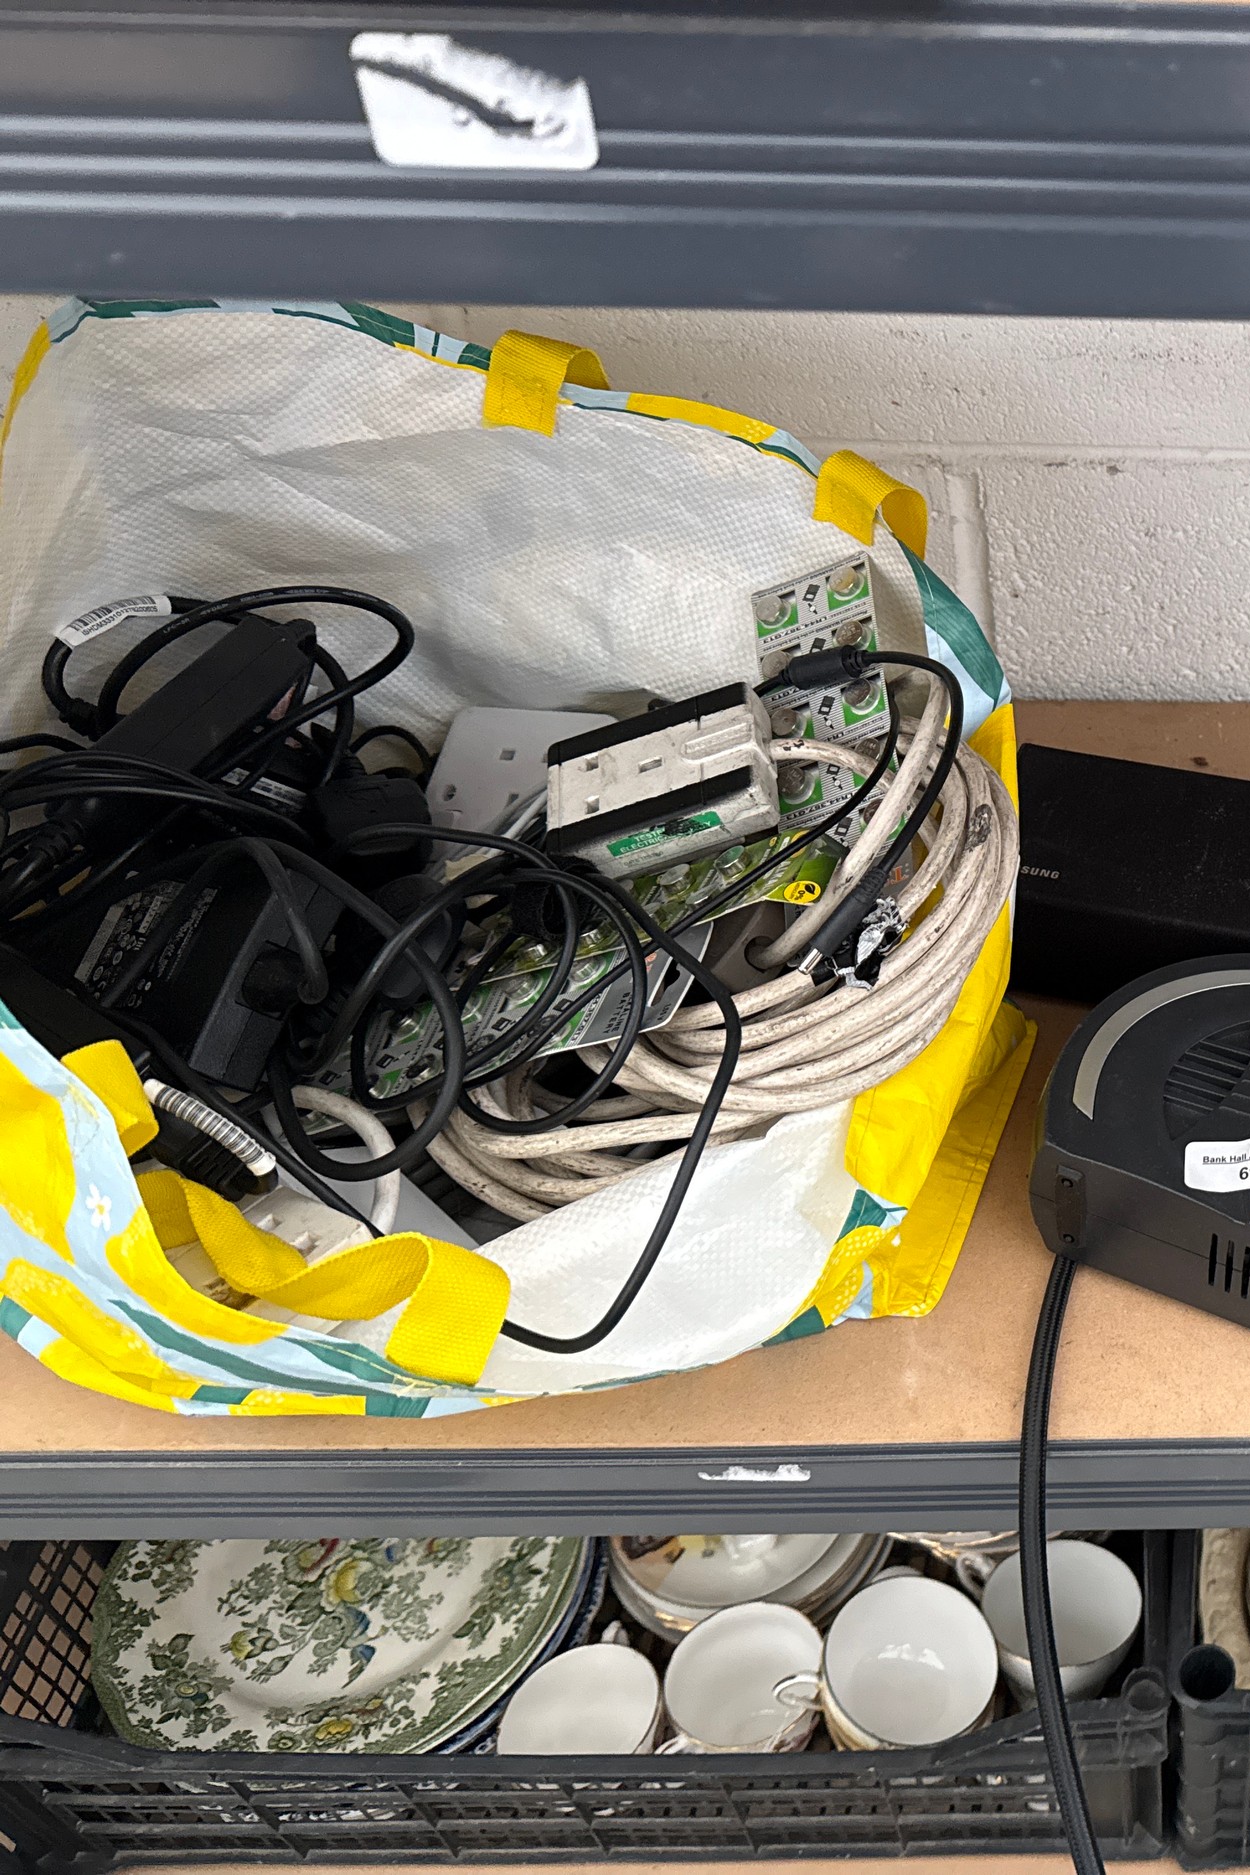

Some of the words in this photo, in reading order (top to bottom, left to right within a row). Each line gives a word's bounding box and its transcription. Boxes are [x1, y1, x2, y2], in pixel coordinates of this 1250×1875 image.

[1020, 865, 1061, 880] SUNG
[1202, 1155, 1227, 1164] Bank
[1229, 1152, 1247, 1163] Hall
